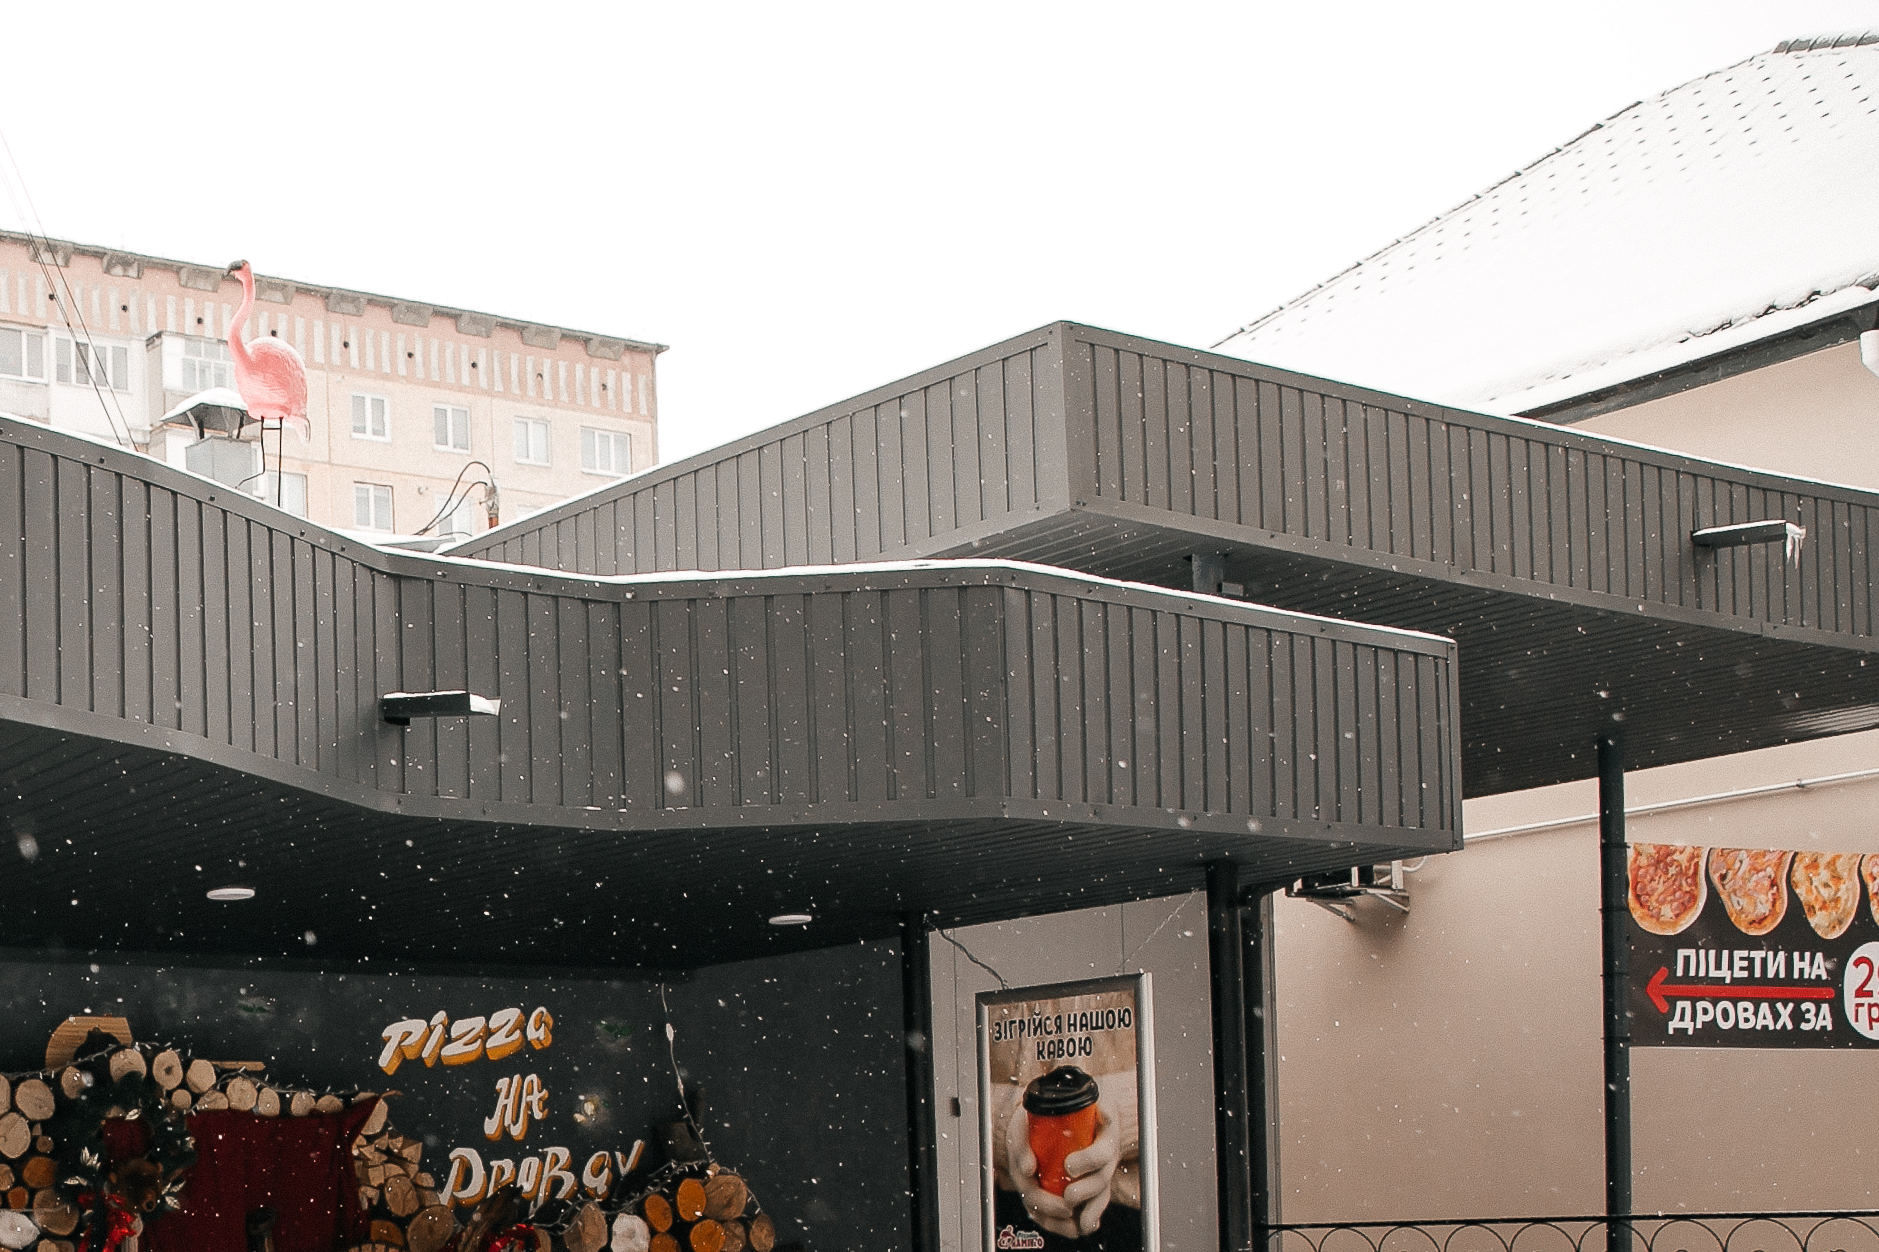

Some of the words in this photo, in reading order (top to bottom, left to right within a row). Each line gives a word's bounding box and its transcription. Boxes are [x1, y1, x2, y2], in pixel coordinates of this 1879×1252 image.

[1676, 949, 1786, 984] ПІЦЕТИ
[1793, 951, 1828, 981] НА
[1852, 956, 1879, 998] 2
[994, 1010, 1063, 1041] ЗІГРІЙСЯ
[1067, 1007, 1132, 1033] НАШОЮ
[1668, 1000, 1793, 1035] ДРОВАХ
[1800, 1002, 1833, 1031] ЗА
[1036, 1036, 1093, 1060] КАВОЮ
